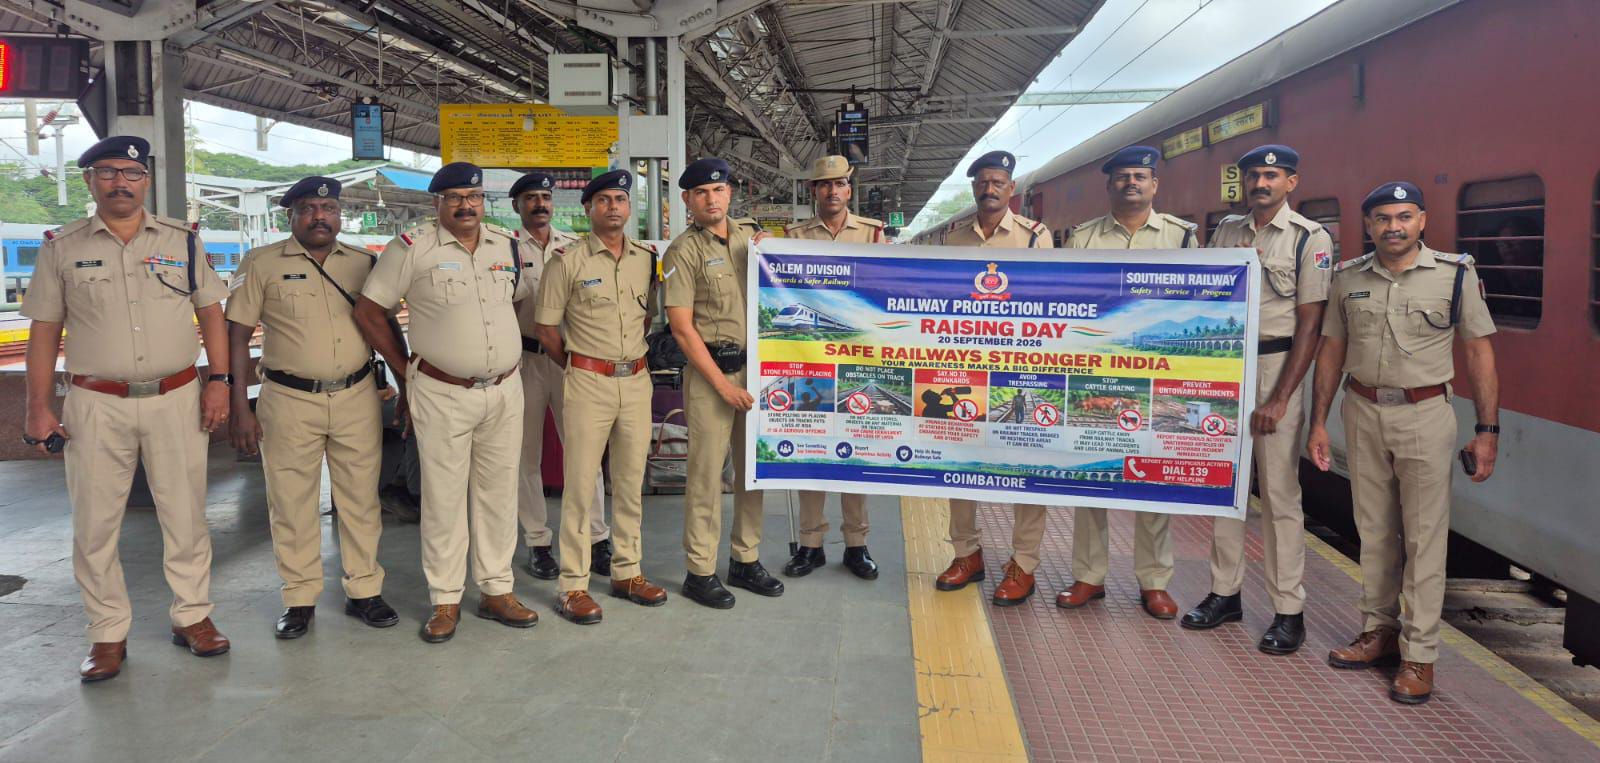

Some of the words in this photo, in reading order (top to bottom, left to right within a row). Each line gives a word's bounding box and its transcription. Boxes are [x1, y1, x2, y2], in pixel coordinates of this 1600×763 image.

[1226, 166, 1237, 179] S
[1227, 186, 1237, 199] 5
[769, 262, 803, 275] SALEM
[806, 263, 851, 276] DIVISION
[823, 278, 850, 287] Railway
[1126, 272, 1185, 286] SOUTHERN
[1188, 273, 1238, 287] RAILWAY
[1129, 286, 1153, 296] Safety
[1201, 288, 1232, 297] Progress
[887, 297, 949, 313] RAILWAY
[953, 299, 1044, 316] PROTECTION
[1048, 302, 1098, 318] FORCE
[920, 318, 1015, 337] RAISING
[1021, 321, 1068, 339] DAY
[953, 336, 1014, 347] SEPTEMBER
[1015, 338, 1042, 347] 2026
[824, 343, 875, 358] SAFE
[881, 346, 983, 363] RAILWAYS
[988, 350, 1103, 367] STRONGER
[1110, 355, 1171, 371] INDIA
[908, 361, 965, 370] AWARENESS
[1031, 366, 1094, 375] DIFFERENCE
[1162, 465, 1186, 475] DIAL
[1190, 466, 1209, 477] 139
[943, 472, 1027, 489] COIMBATORE
